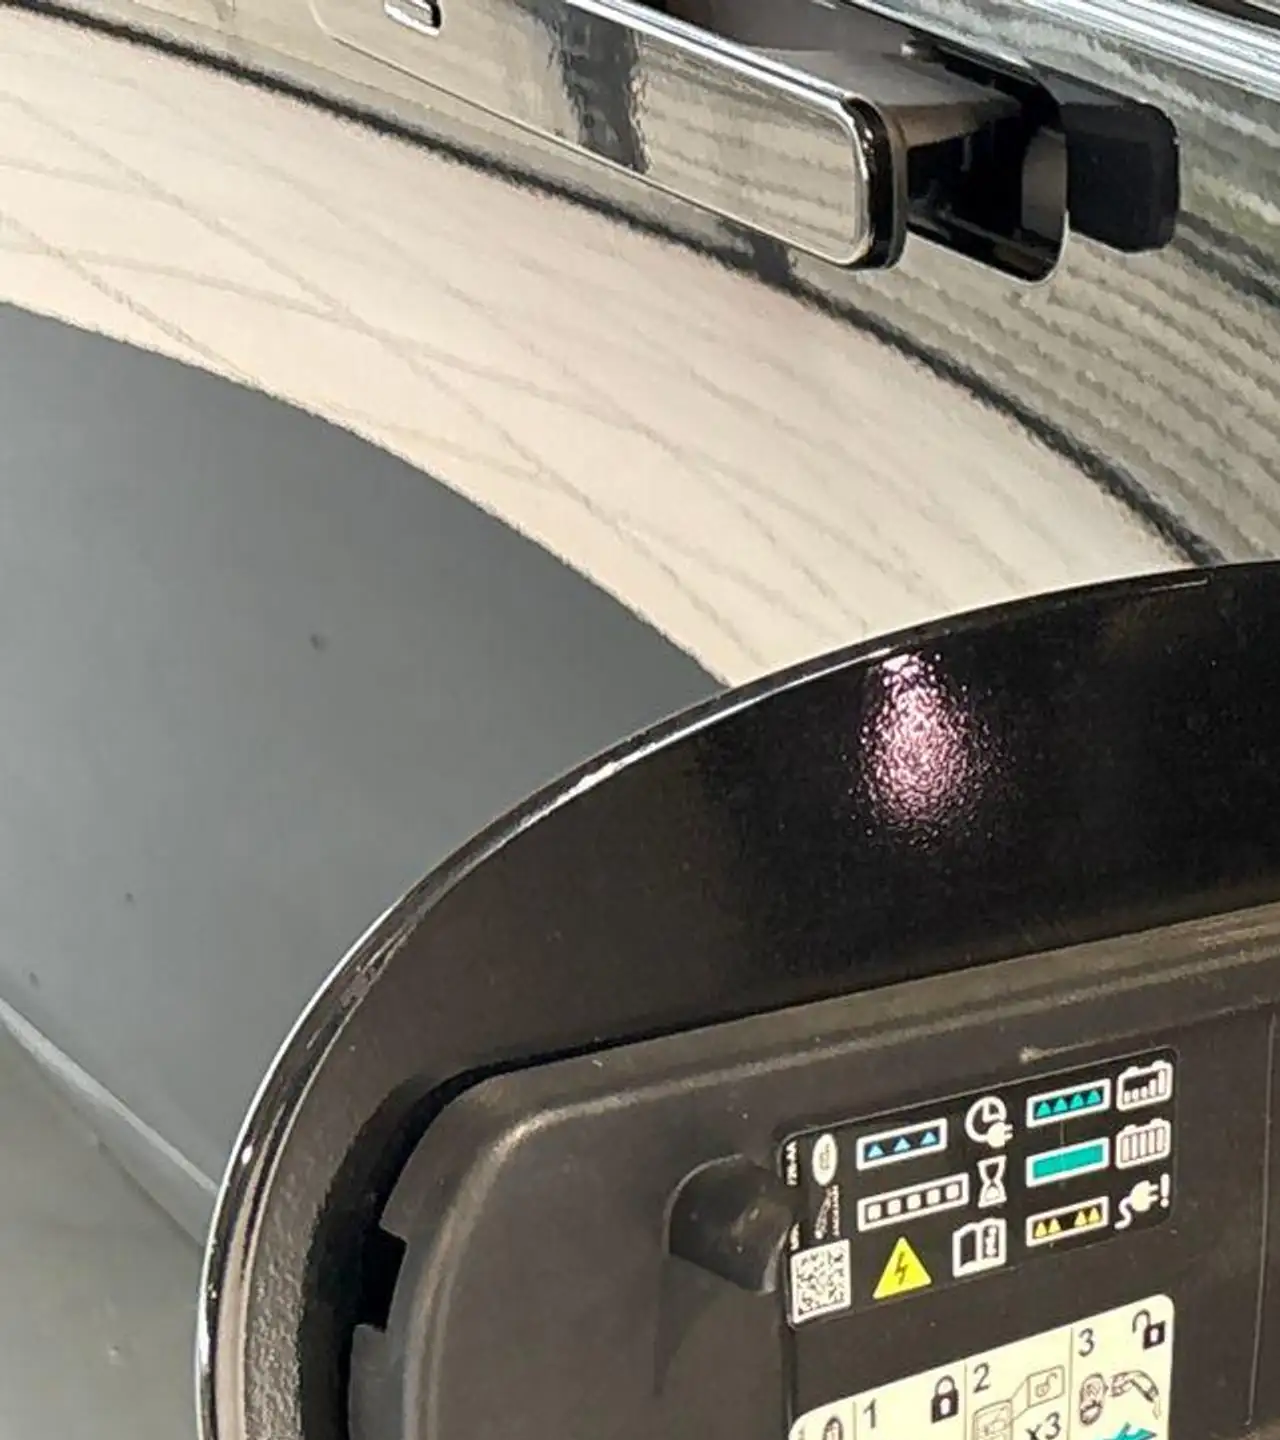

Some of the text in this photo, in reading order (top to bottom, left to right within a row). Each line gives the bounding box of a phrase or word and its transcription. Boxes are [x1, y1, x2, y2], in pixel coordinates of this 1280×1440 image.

[1076, 1327, 1096, 1358] 3
[972, 1361, 991, 1395] 2
[862, 1397, 878, 1430] 1
